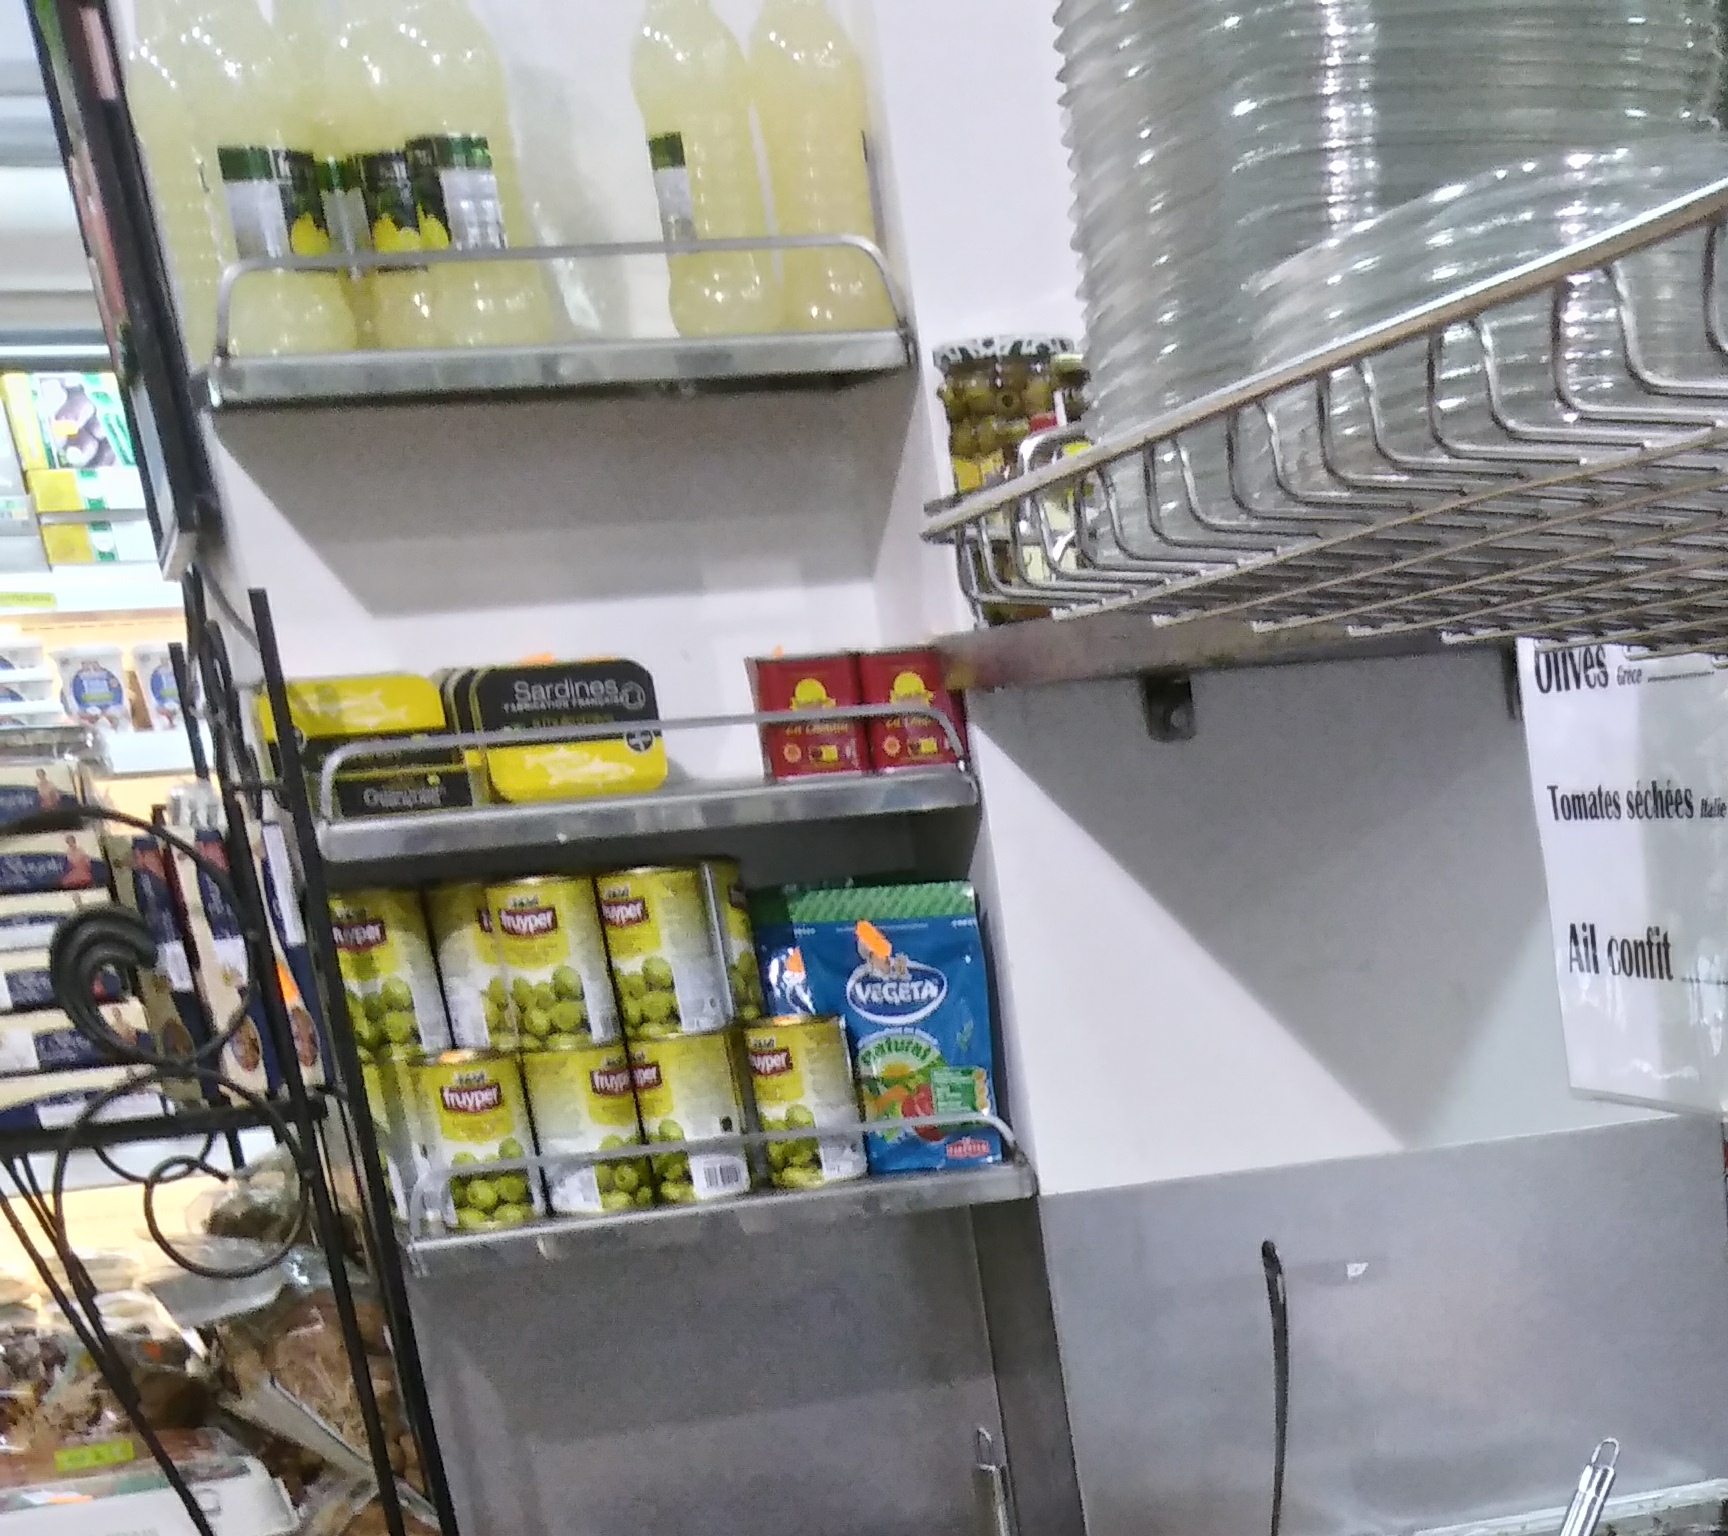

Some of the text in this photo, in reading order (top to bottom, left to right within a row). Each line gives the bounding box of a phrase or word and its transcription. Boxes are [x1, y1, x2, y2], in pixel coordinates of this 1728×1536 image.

[514, 678, 619, 702] Sardines
[1547, 785, 1622, 821] Tomates
[1626, 780, 1694, 820] séchées
[500, 909, 553, 933] fruyper
[1569, 923, 1600, 975] Ail
[1607, 926, 1674, 981] confit
[855, 980, 939, 1005] VEGETA
[443, 1086, 499, 1112] fruyper
